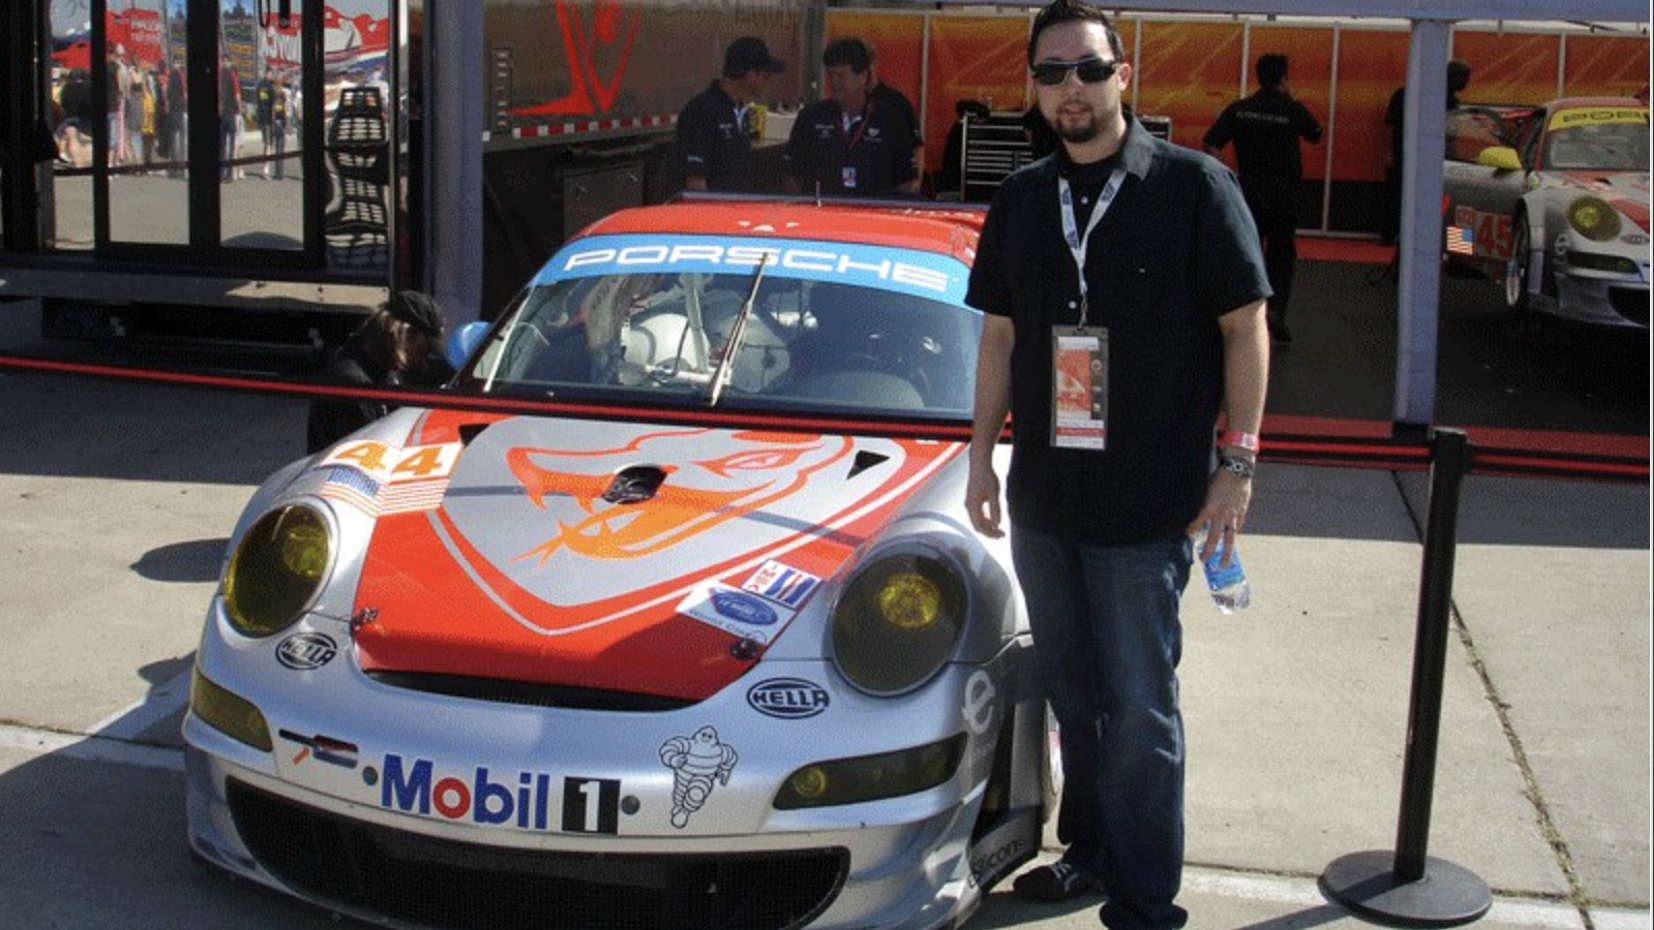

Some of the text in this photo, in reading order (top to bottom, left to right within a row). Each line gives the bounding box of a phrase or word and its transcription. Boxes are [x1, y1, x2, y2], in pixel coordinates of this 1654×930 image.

[1477, 214, 1513, 258] 45
[563, 244, 950, 292] PORSCHE
[334, 442, 443, 476] 44
[281, 639, 337, 666] HELLA
[752, 688, 830, 708] HELLA
[381, 754, 550, 830] Mobil
